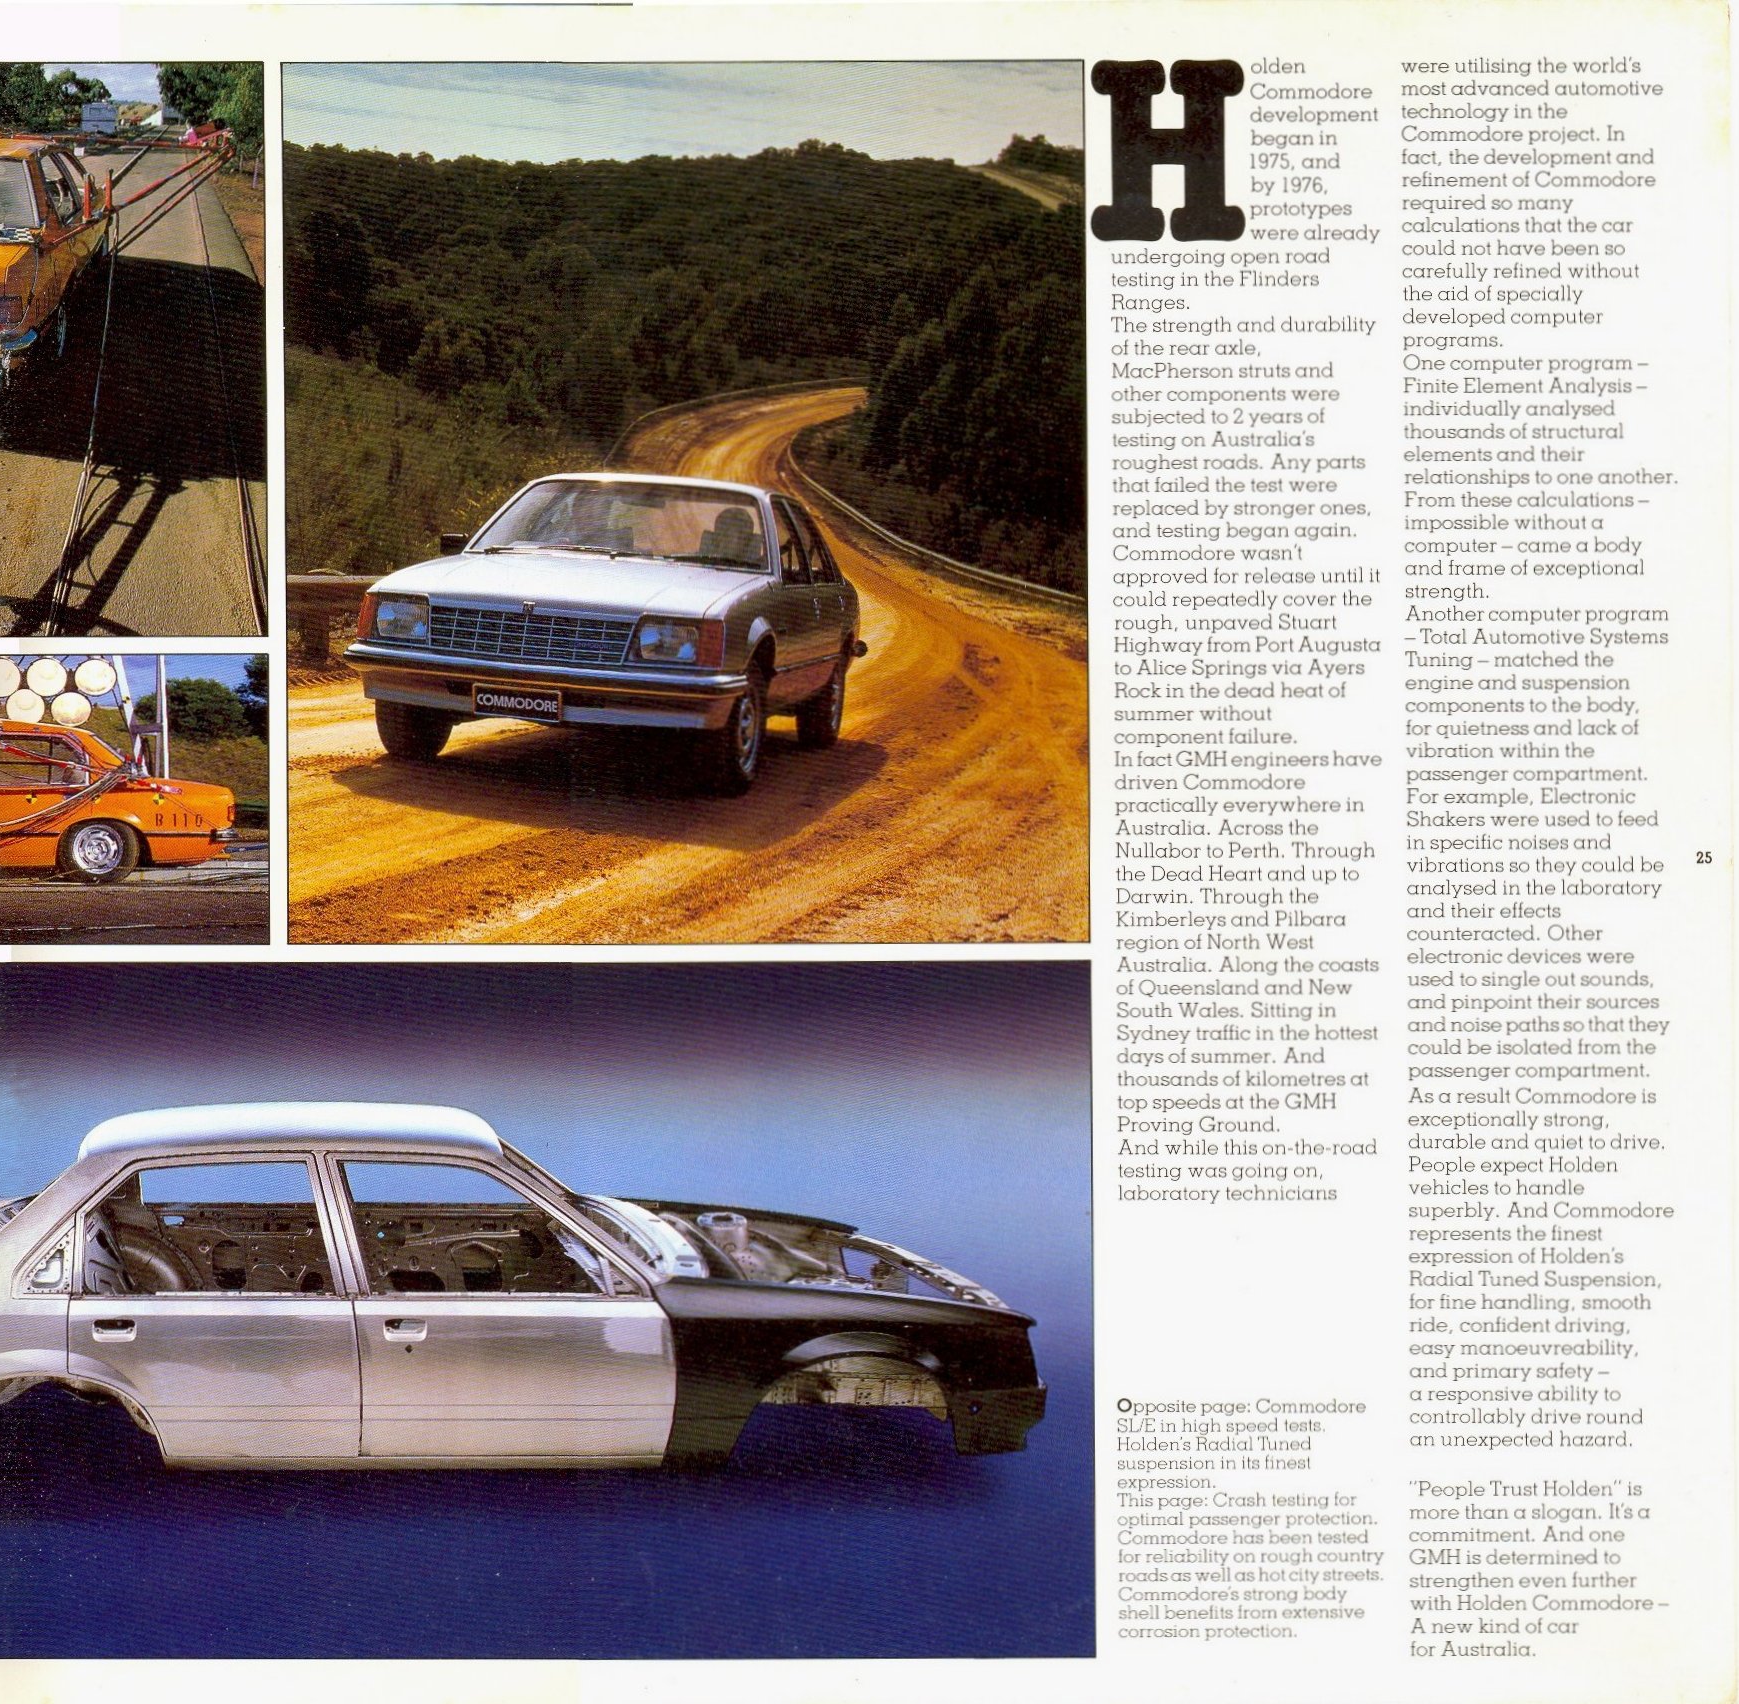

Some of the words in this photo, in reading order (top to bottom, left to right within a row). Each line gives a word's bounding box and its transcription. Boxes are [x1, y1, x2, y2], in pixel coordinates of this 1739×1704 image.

[1251, 57, 1305, 74] olden
[1401, 62, 1449, 73] were
[1455, 57, 1531, 77] utilising
[1537, 56, 1567, 73] the
[1573, 56, 1641, 73] world's
[1250, 82, 1373, 100] Commodore
[1250, 106, 1378, 126] development
[1251, 129, 1314, 149] began
[1319, 131, 1337, 145] in
[1251, 153, 1294, 171] 1975,
[1302, 152, 1340, 169] and
[1402, 148, 1442, 166] fact,
[1449, 149, 1479, 164] the
[1484, 148, 1611, 168] development
[1616, 148, 1654, 164] and
[1251, 176, 1275, 196] by
[1283, 176, 1327, 195] 1976,
[1250, 202, 1352, 220] prototypes
[1250, 229, 1299, 240] were
[1304, 224, 1380, 244] already
[1402, 240, 1456, 256] could
[1461, 242, 1491, 255] not
[1497, 239, 1545, 256] have
[1551, 239, 1599, 256] been
[1605, 244, 1625, 255] so
[1111, 248, 1225, 267] undergoing
[1231, 252, 1280, 267] open
[1286, 247, 1330, 264] road
[1112, 294, 1189, 313] Ranges.
[1111, 339, 1129, 356] of
[1134, 339, 1164, 355] the
[1169, 344, 1210, 355] rear
[1215, 339, 1260, 357] axle,
[1403, 336, 1503, 351] programs.
[1113, 433, 1177, 450] testing
[1181, 436, 1206, 447] on
[1211, 430, 1315, 447] Australia's
[1404, 468, 1530, 488] relationships
[1535, 471, 1552, 484] to
[1557, 473, 1593, 484] one
[1598, 468, 1678, 484] another.
[1113, 522, 1151, 538] and
[1156, 524, 1221, 541] testing
[1226, 521, 1289, 541] began
[1294, 523, 1356, 541] again.
[1406, 582, 1489, 602] strength.
[1115, 614, 1178, 633] rough,
[1185, 613, 1272, 634] unpaved
[1279, 613, 1336, 630] Stuart
[1405, 676, 1474, 693] engine
[1478, 674, 1516, 690] and
[1522, 675, 1630, 694] suspension
[476, 694, 558, 712] COMMODORE
[1114, 710, 1194, 721] summer
[1199, 705, 1272, 721] without
[1114, 774, 1178, 790] driven
[1183, 773, 1305, 790] Commodore
[1406, 770, 1508, 785] passenger
[1513, 767, 1647, 785] compartment.
[1115, 796, 1218, 816] practically
[1223, 796, 1341, 816] everywhere
[1346, 797, 1364, 812] in
[1407, 856, 1504, 872] vibrations
[1510, 861, 1530, 873] so
[1536, 856, 1577, 876] they
[1582, 856, 1634, 872] could
[1641, 856, 1664, 872] be
[1696, 851, 1713, 864] 25
[1116, 888, 1193, 904] Darwin.
[1200, 887, 1283, 908] Through
[1289, 887, 1318, 904] the
[1407, 948, 1502, 964] electronic
[1507, 947, 1581, 964] devices
[1587, 952, 1634, 963] were
[1116, 979, 1134, 995] of
[1138, 979, 1259, 997] Queensland
[1264, 979, 1303, 995] and
[1309, 978, 1352, 995] New
[1408, 1039, 1462, 1055] could
[1467, 1039, 1492, 1055] be
[1497, 1038, 1572, 1055] isolated
[1578, 1038, 1621, 1055] from
[1627, 1038, 1656, 1055] the
[1118, 1070, 1218, 1086] thousands
[1223, 1070, 1240, 1086] of
[1246, 1070, 1346, 1087] kilometres
[1350, 1072, 1368, 1086] at
[1118, 1163, 1181, 1181] testing
[1188, 1167, 1227, 1178] was
[1232, 1162, 1288, 1181] going
[1294, 1167, 1322, 1180] on,
[1409, 1156, 1475, 1175] People
[1481, 1158, 1543, 1176] expect
[1549, 1156, 1618, 1173] Holden
[1117, 1398, 1196, 1416] Opposite
[1201, 1403, 1250, 1416] page:
[1256, 1398, 1366, 1414] Commodore
[1117, 1418, 1155, 1433] SL/E
[1161, 1420, 1176, 1432] in
[1182, 1418, 1221, 1435] high
[1226, 1417, 1278, 1435] speed
[1284, 1419, 1325, 1432] tests.
[1117, 1437, 1191, 1451] Holden's
[1196, 1436, 1253, 1451] Radial
[1258, 1436, 1311, 1451] Tuned
[1118, 1456, 1215, 1473] suspension
[1221, 1456, 1236, 1469] in
[1242, 1456, 1259, 1469] its
[1265, 1454, 1310, 1469] finest
[1118, 1479, 1215, 1492] expression.
[1117, 1493, 1153, 1507] This
[1158, 1497, 1207, 1510] page:
[1213, 1492, 1266, 1507] Crash
[1273, 1494, 1329, 1509] testing
[1335, 1492, 1356, 1506] for
[1117, 1512, 1184, 1529] optimal
[1189, 1515, 1280, 1529] passenger
[1286, 1512, 1377, 1528] protection.
[1118, 1530, 1228, 1545] Commodore
[1233, 1530, 1264, 1544] has
[1269, 1530, 1312, 1544] been
[1318, 1529, 1368, 1544] tested
[1119, 1549, 1141, 1563] for
[1146, 1548, 1229, 1566] reliability
[1233, 1553, 1255, 1563] on
[1261, 1548, 1312, 1565] rough
[1317, 1550, 1384, 1565] country
[1119, 1568, 1169, 1582] roads
[1170, 1573, 1191, 1582] as
[1195, 1567, 1231, 1582] well
[1235, 1572, 1255, 1582] as
[1259, 1567, 1285, 1582] hot
[1289, 1569, 1319, 1584] city
[1323, 1569, 1383, 1581] streets.
[1118, 1587, 1239, 1601] Commodore's
[1244, 1589, 1298, 1603] strong
[1304, 1586, 1347, 1603] body
[1119, 1605, 1159, 1619] shell
[1165, 1605, 1233, 1619] benefits
[1238, 1605, 1277, 1619] from
[1282, 1608, 1365, 1618] extensive
[1118, 1625, 1200, 1638] corrosion
[1205, 1625, 1297, 1641] protection.
